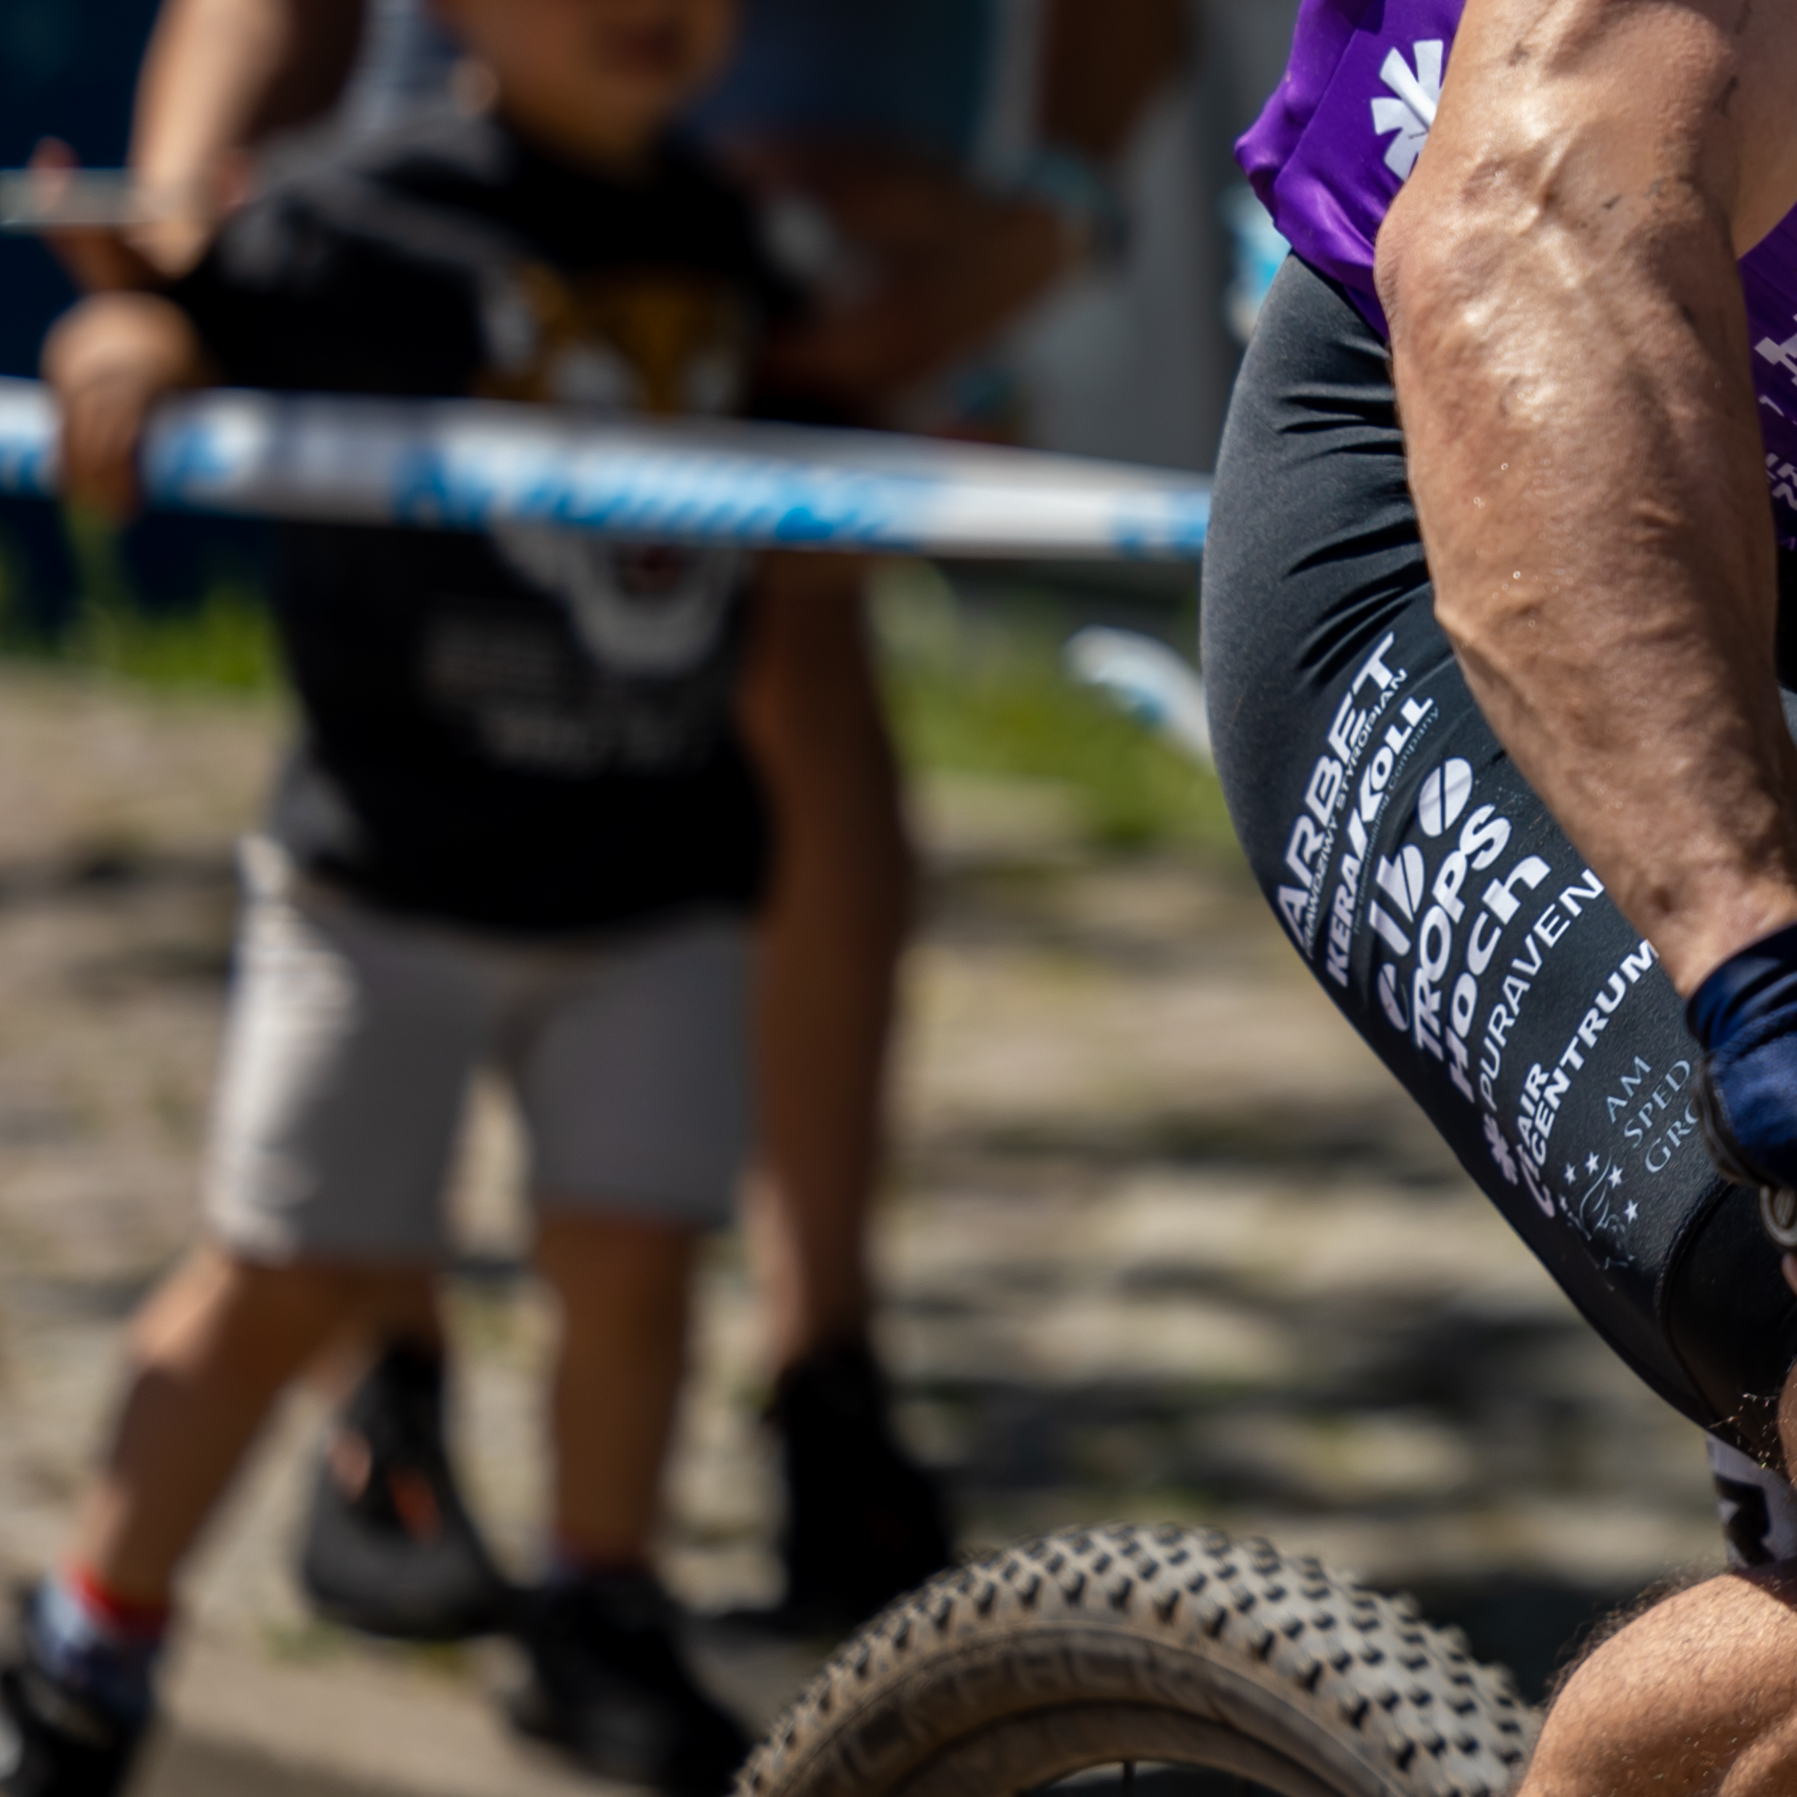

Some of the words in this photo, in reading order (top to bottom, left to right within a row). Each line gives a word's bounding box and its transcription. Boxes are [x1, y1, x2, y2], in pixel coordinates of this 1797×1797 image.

[1277, 630, 1395, 953] ARBET
[1334, 668, 1408, 812] STYROPIAN
[1325, 696, 1434, 988] KERAKOLL
[1411, 803, 1512, 1061] TROPS
[1479, 868, 1604, 1112] PURAVEN
[1517, 1062, 1551, 1140] AIR
[1605, 1054, 1653, 1124] AM
[1623, 1058, 1692, 1150] SPED
